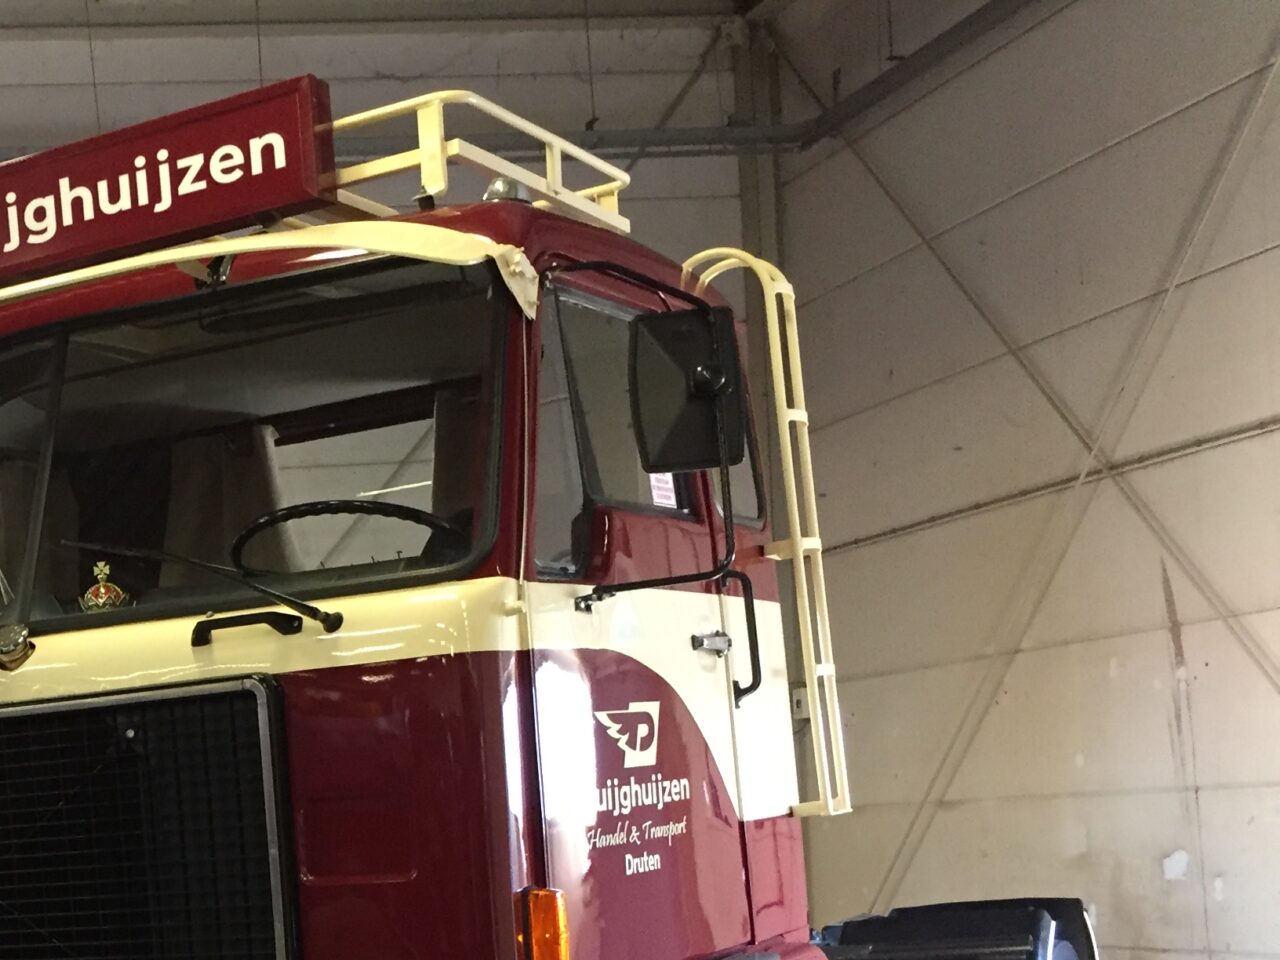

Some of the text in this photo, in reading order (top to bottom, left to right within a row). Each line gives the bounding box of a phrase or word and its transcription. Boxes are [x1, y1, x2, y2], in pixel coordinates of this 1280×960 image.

[596, 773, 690, 816] uijghuijzen
[587, 816, 687, 850] Handel & Transport
[625, 851, 661, 876] Druten
